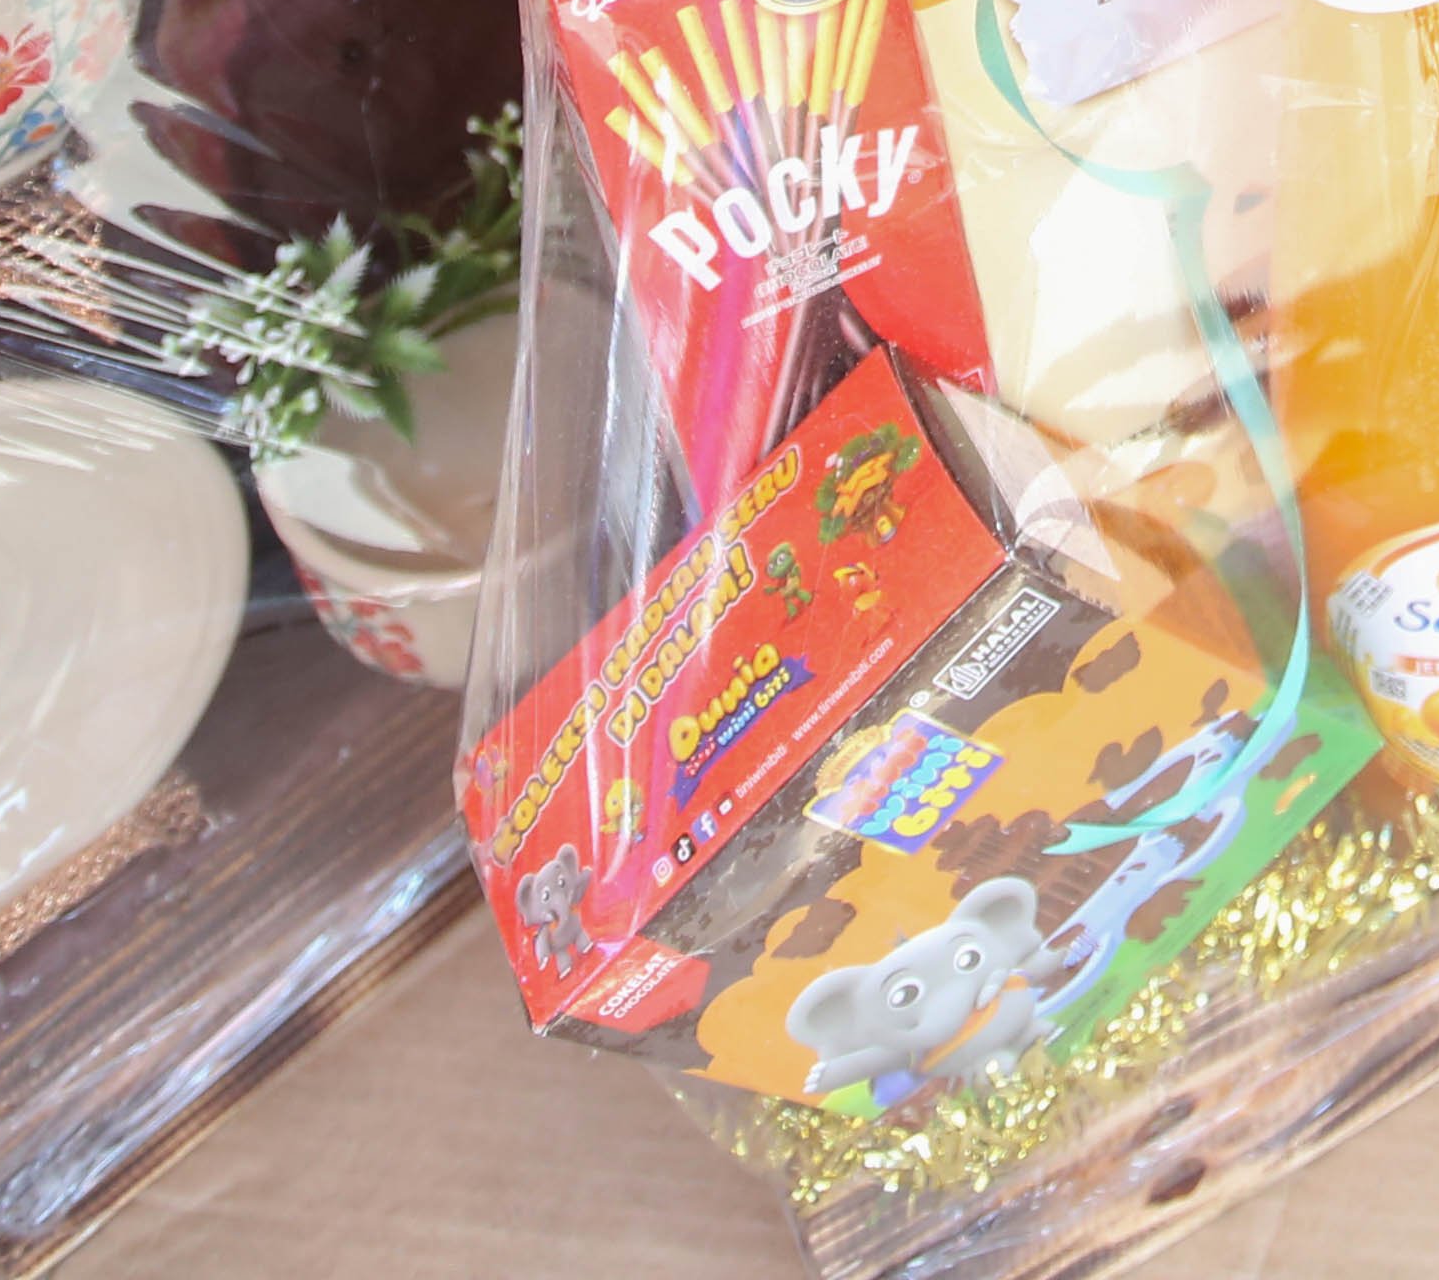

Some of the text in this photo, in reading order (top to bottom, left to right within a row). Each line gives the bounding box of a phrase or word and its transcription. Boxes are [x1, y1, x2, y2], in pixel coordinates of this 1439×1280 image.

[647, 124, 920, 293] Pocky
[602, 534, 717, 689] HADIAH
[718, 445, 801, 543] SERU
[638, 541, 755, 703] DALAM!
[969, 595, 1041, 663] HALAL
[668, 642, 780, 763] Dunia
[734, 741, 788, 799] tiniwinibiti
[597, 951, 667, 1017] COKELAT
[613, 958, 679, 1020] CHOCOLATE
